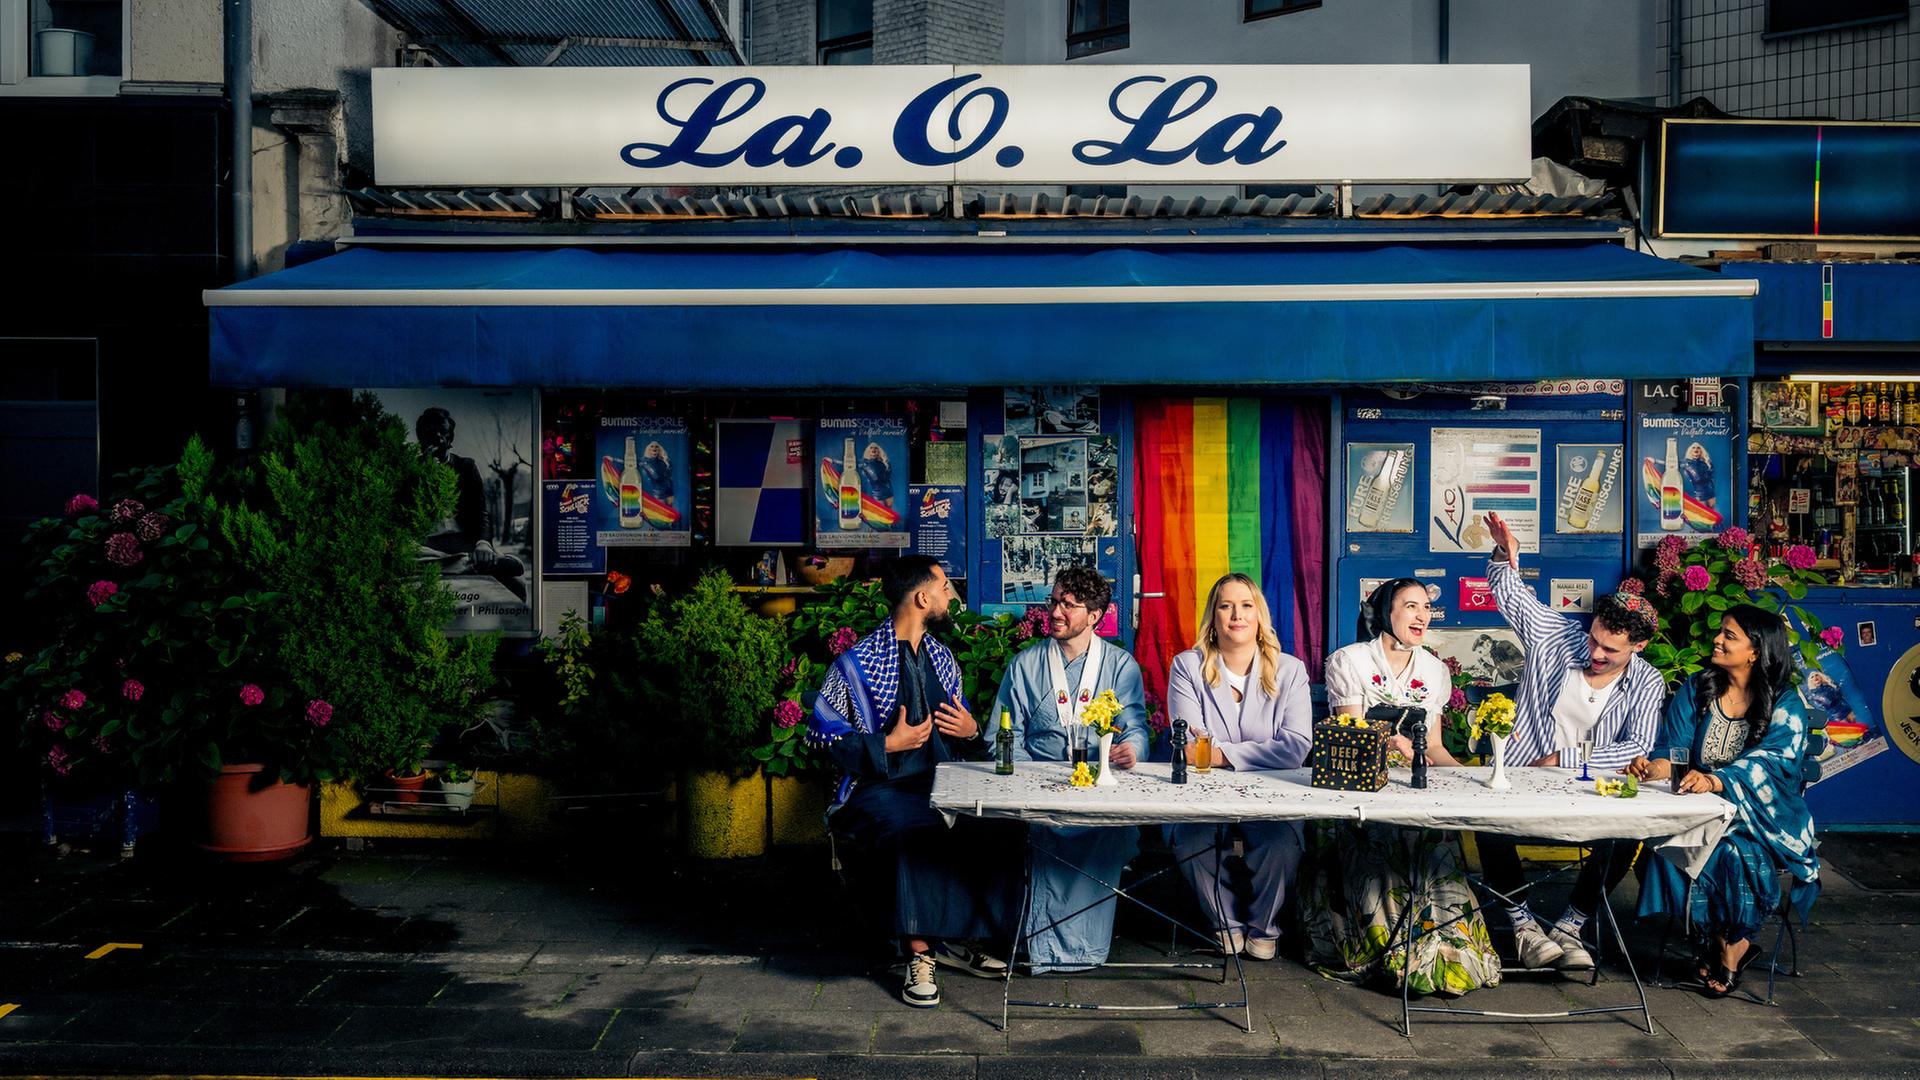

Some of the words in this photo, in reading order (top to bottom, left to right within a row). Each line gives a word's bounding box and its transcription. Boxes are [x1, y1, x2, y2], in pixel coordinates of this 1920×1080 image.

[620, 77, 863, 168] La.
[892, 73, 1025, 167] O.
[1071, 75, 1288, 166] La
[1558, 476, 1582, 519] PURE
[1587, 448, 1622, 530] ERFRISCHUNG
[478, 606, 529, 617] Philosoph
[1330, 745, 1359, 759] DEEP
[1330, 758, 1358, 772] TALK
